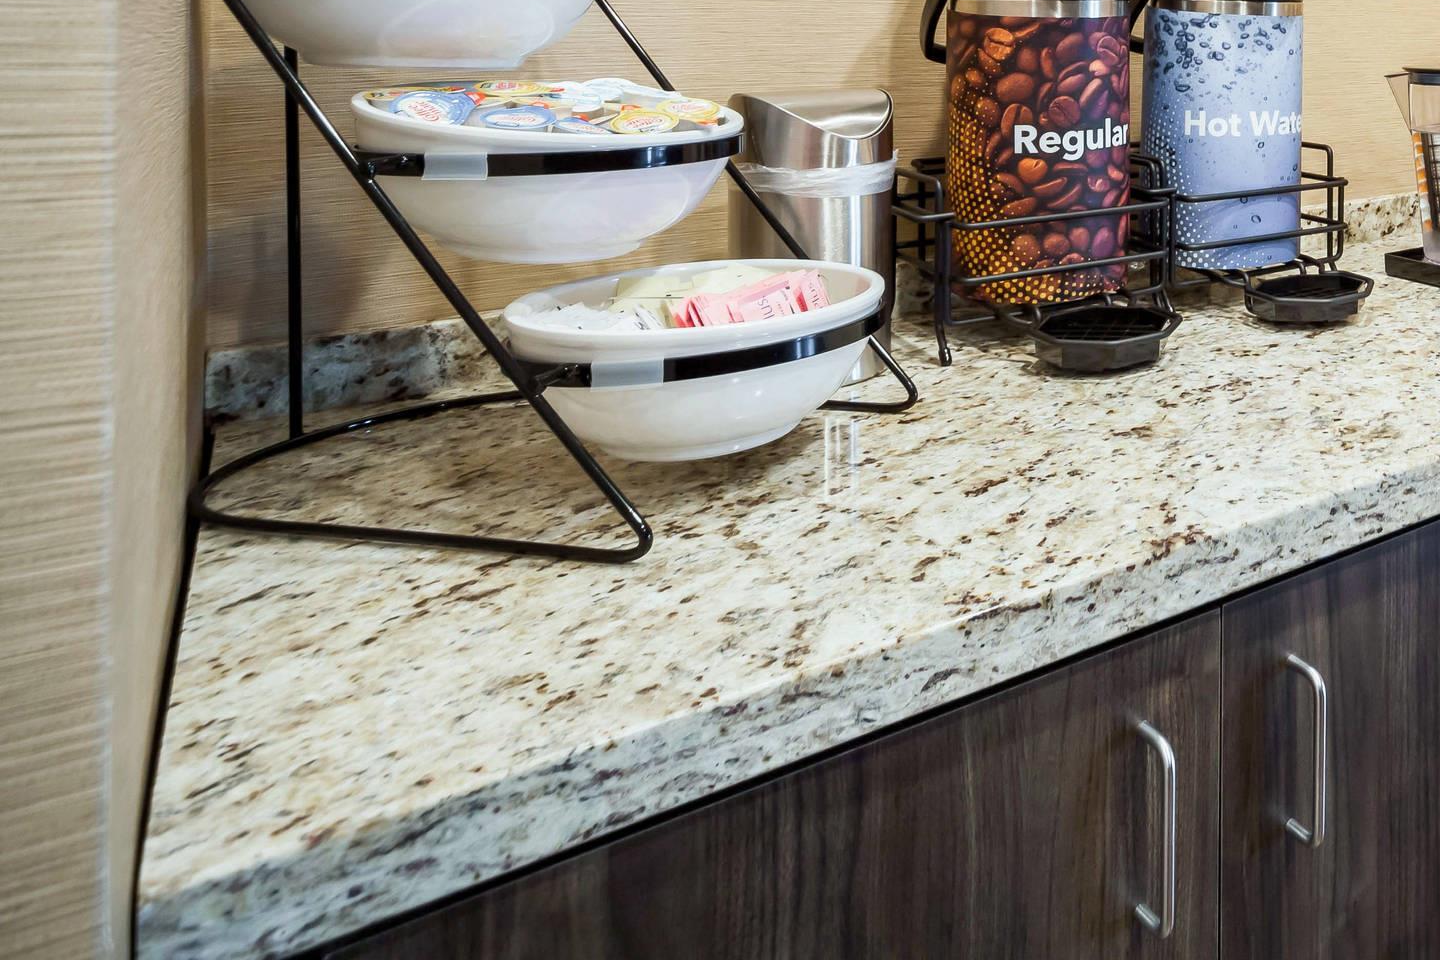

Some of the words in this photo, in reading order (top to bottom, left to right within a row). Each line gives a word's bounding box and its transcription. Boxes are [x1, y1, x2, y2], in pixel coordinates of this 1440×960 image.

[1013, 117, 1129, 161] Regular
[1184, 109, 1241, 137] Hot
[1248, 109, 1301, 137] Wate
